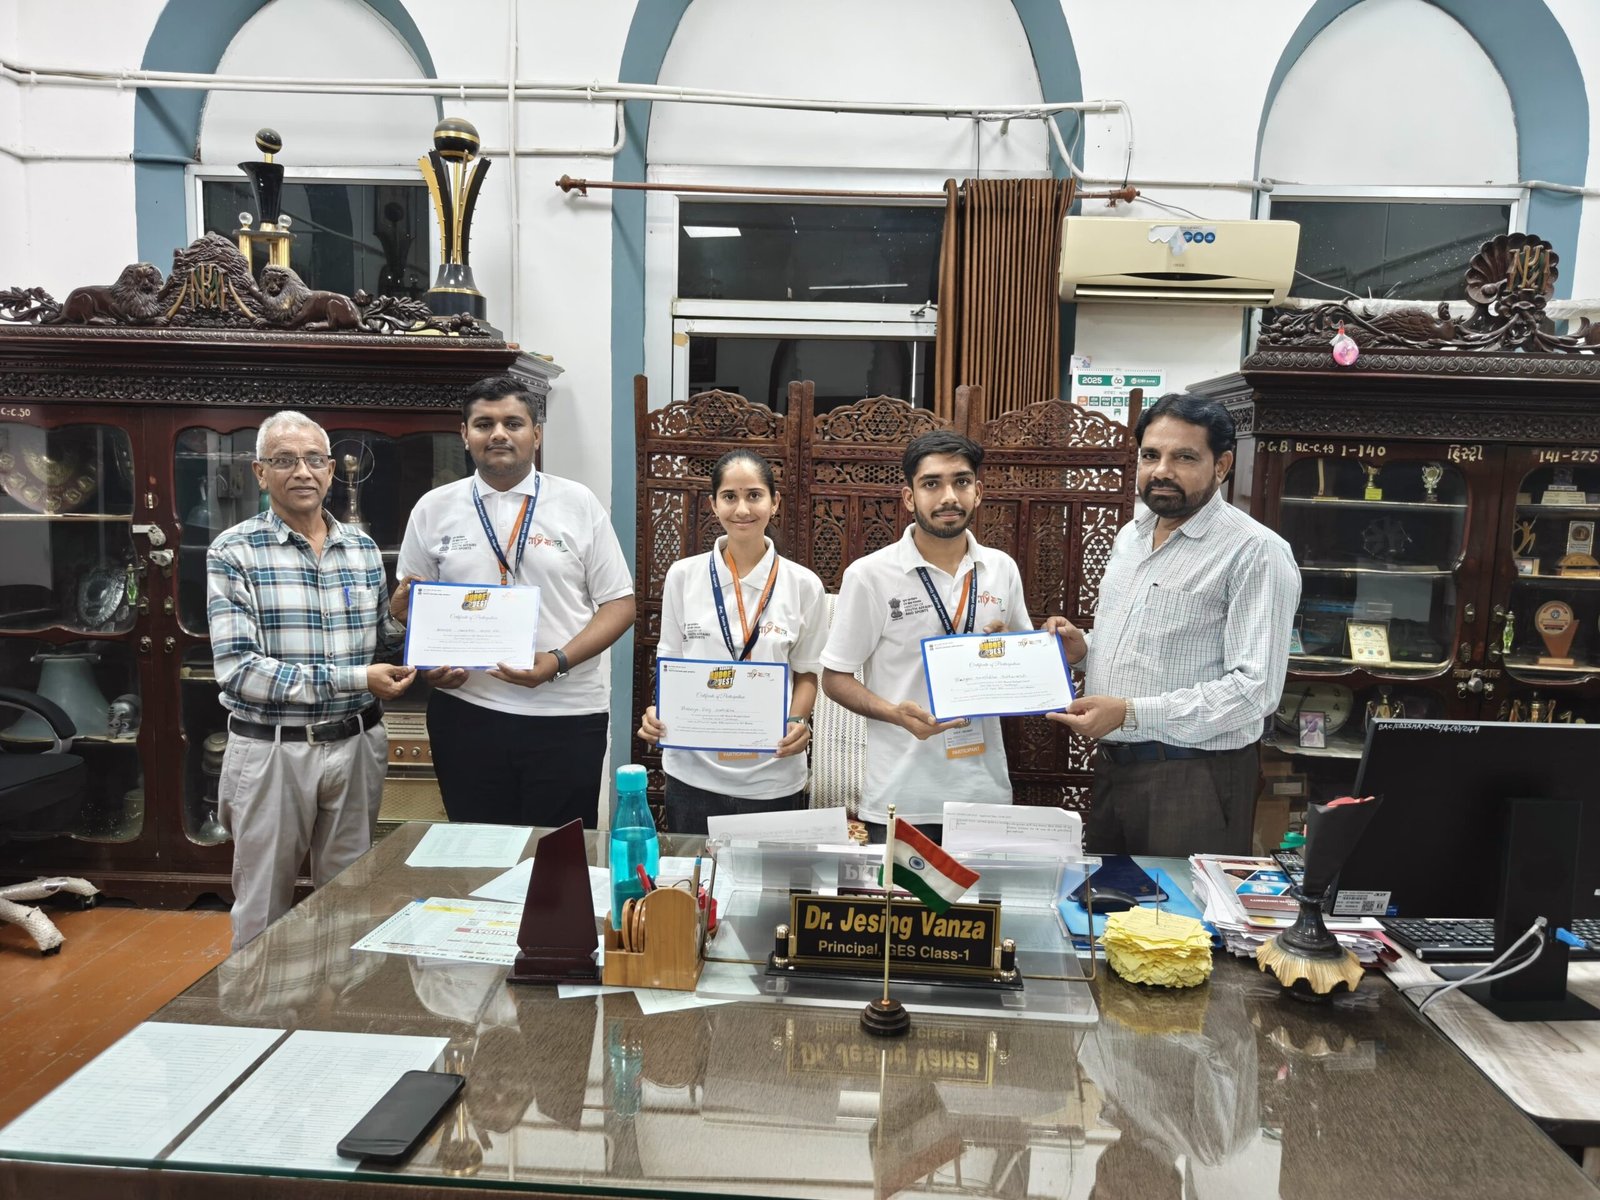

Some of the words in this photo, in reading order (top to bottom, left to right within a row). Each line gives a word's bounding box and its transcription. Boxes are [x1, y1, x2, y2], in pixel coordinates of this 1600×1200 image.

[1082, 376, 1102, 384] 2025
[1539, 450, 1599, 463] 141-275
[804, 905, 832, 931] Dr.
[840, 906, 913, 940] Jesing
[920, 911, 986, 940] Vanza
[888, 943, 916, 958] GES
[919, 945, 970, 961] Class-1
